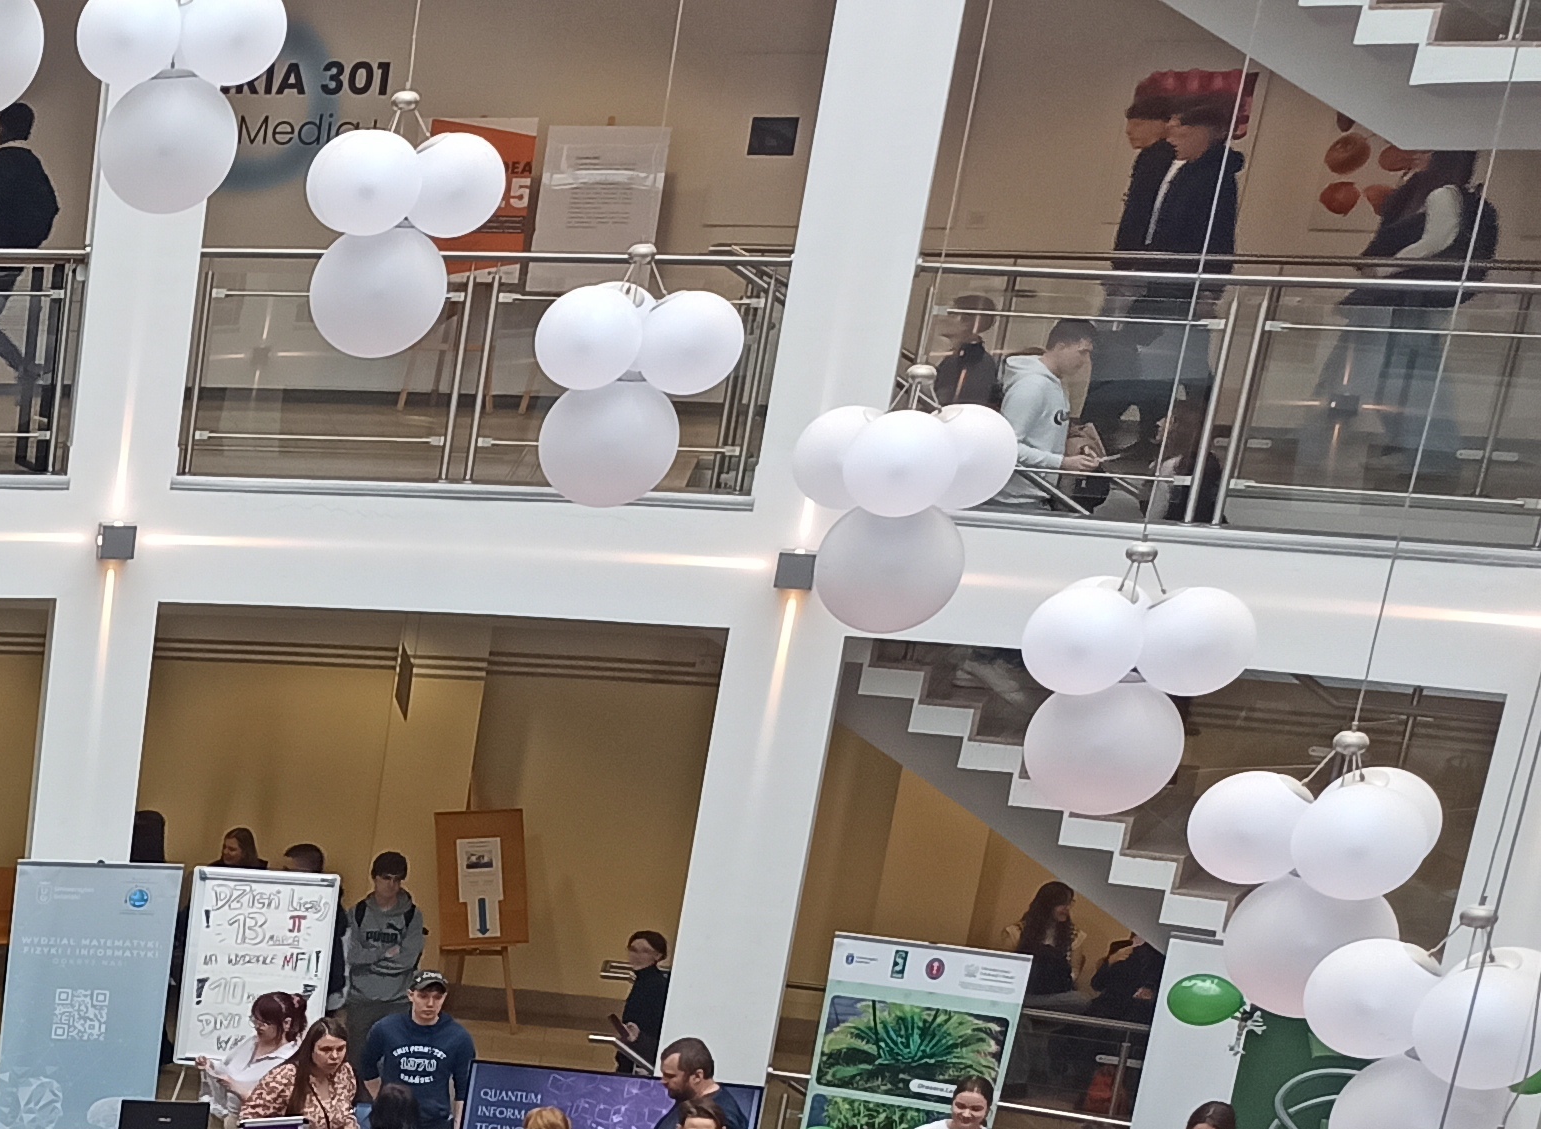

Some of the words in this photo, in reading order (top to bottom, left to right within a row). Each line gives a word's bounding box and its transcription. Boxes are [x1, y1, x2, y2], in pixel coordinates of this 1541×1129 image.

[320, 60, 391, 96] 301
[228, 912, 268, 946] 13
[366, 931, 399, 944] PUMA
[23, 946, 62, 955] FIZYKI
[76, 948, 159, 958] INFORMATYKI
[480, 1089, 542, 1104] QUANTUM
[478, 1105, 525, 1120] INFORM
